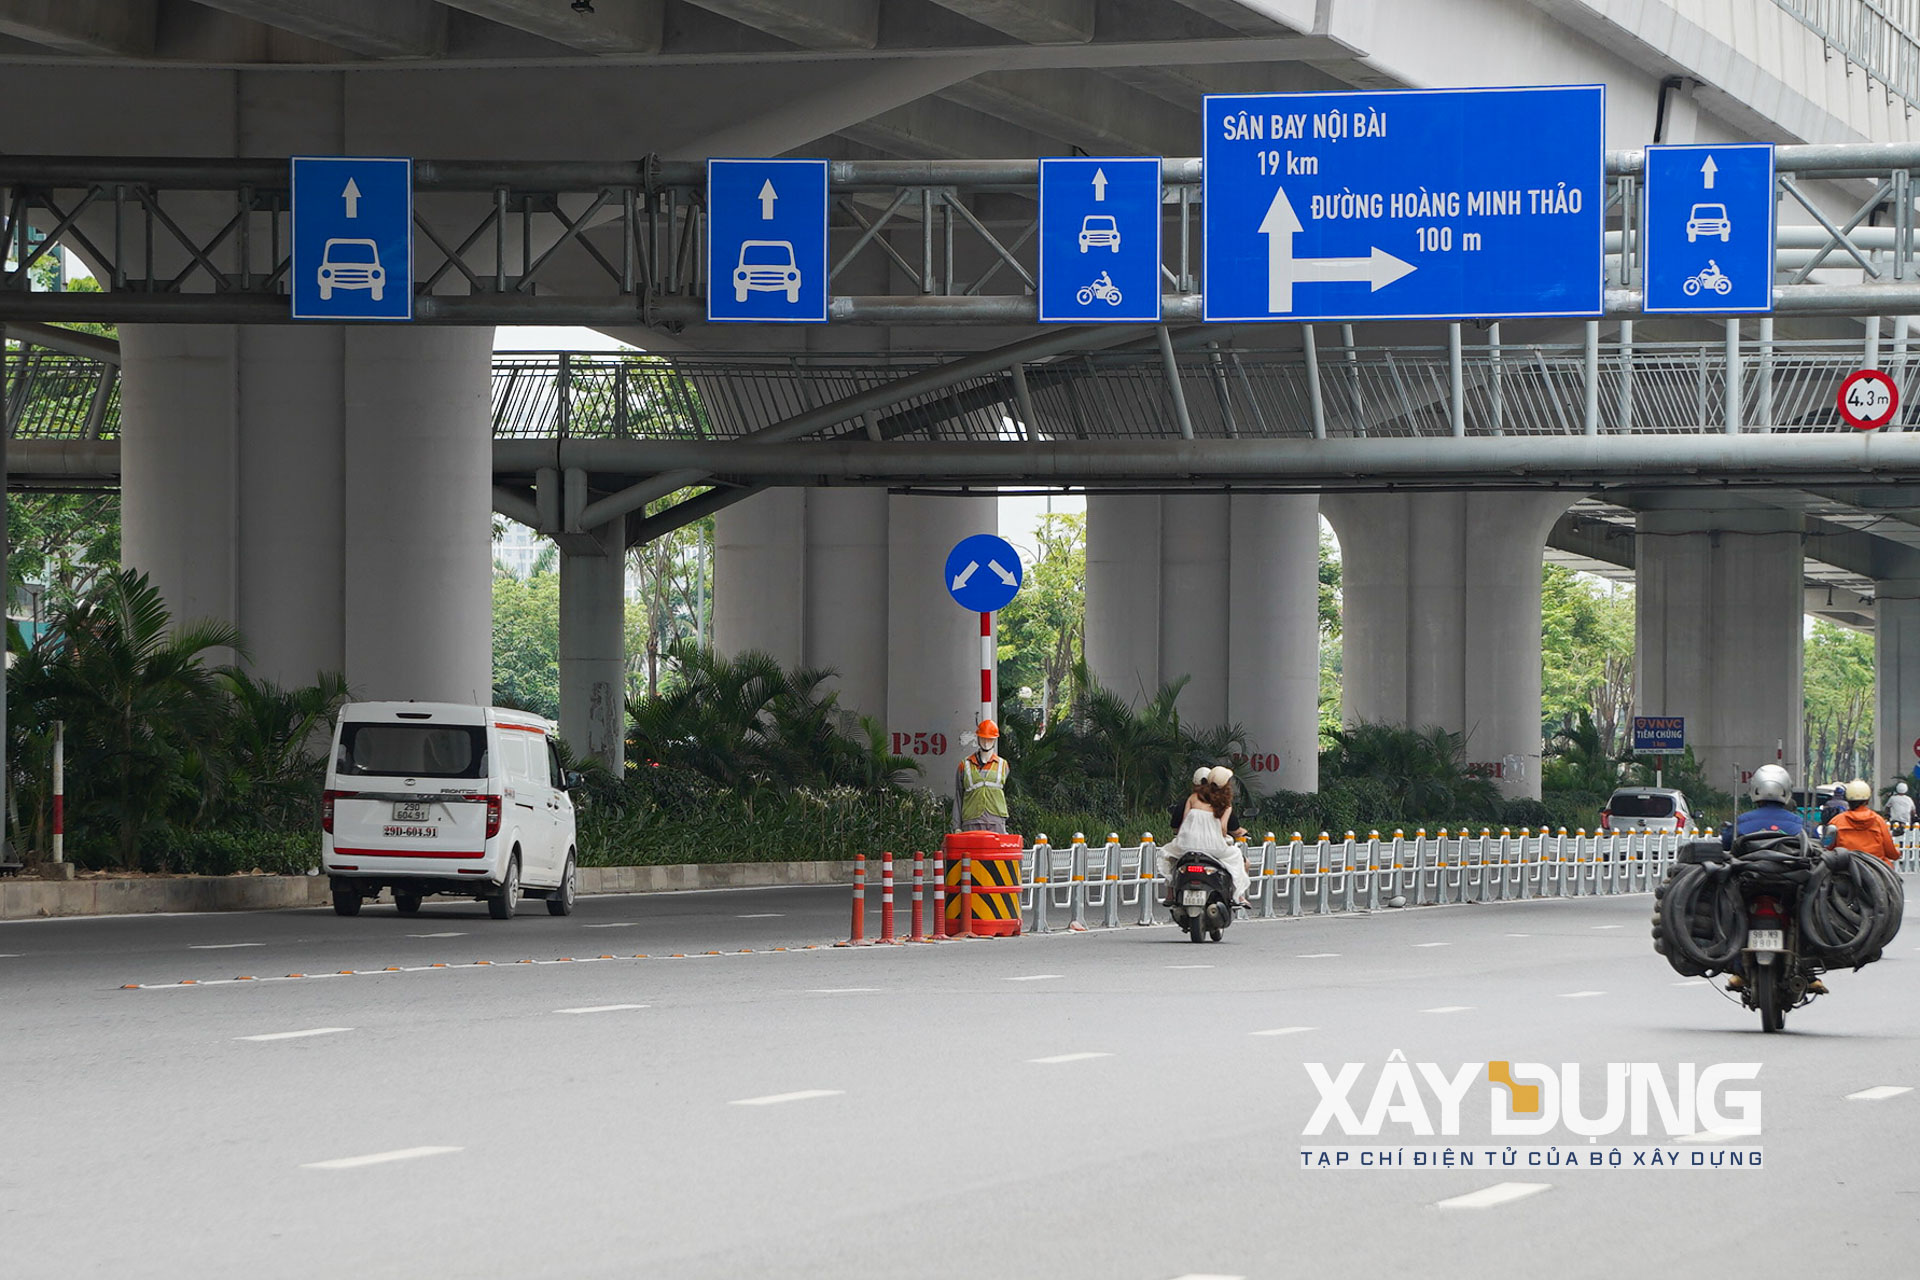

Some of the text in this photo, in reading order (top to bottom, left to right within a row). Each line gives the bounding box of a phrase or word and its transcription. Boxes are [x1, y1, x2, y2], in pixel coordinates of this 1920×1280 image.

[1223, 106, 1387, 143] SÂN BAY NỘI BÀI
[1257, 150, 1319, 176] 19 km
[1310, 181, 1582, 220] ĐƯỜNG HOÀNG MINH THẢO
[1416, 226, 1481, 252] 100 m
[1648, 719, 1682, 729] VNVC
[891, 732, 947, 756] P59
[397, 811, 425, 820] 604.91
[384, 826, 437, 837] 29D-604.91
